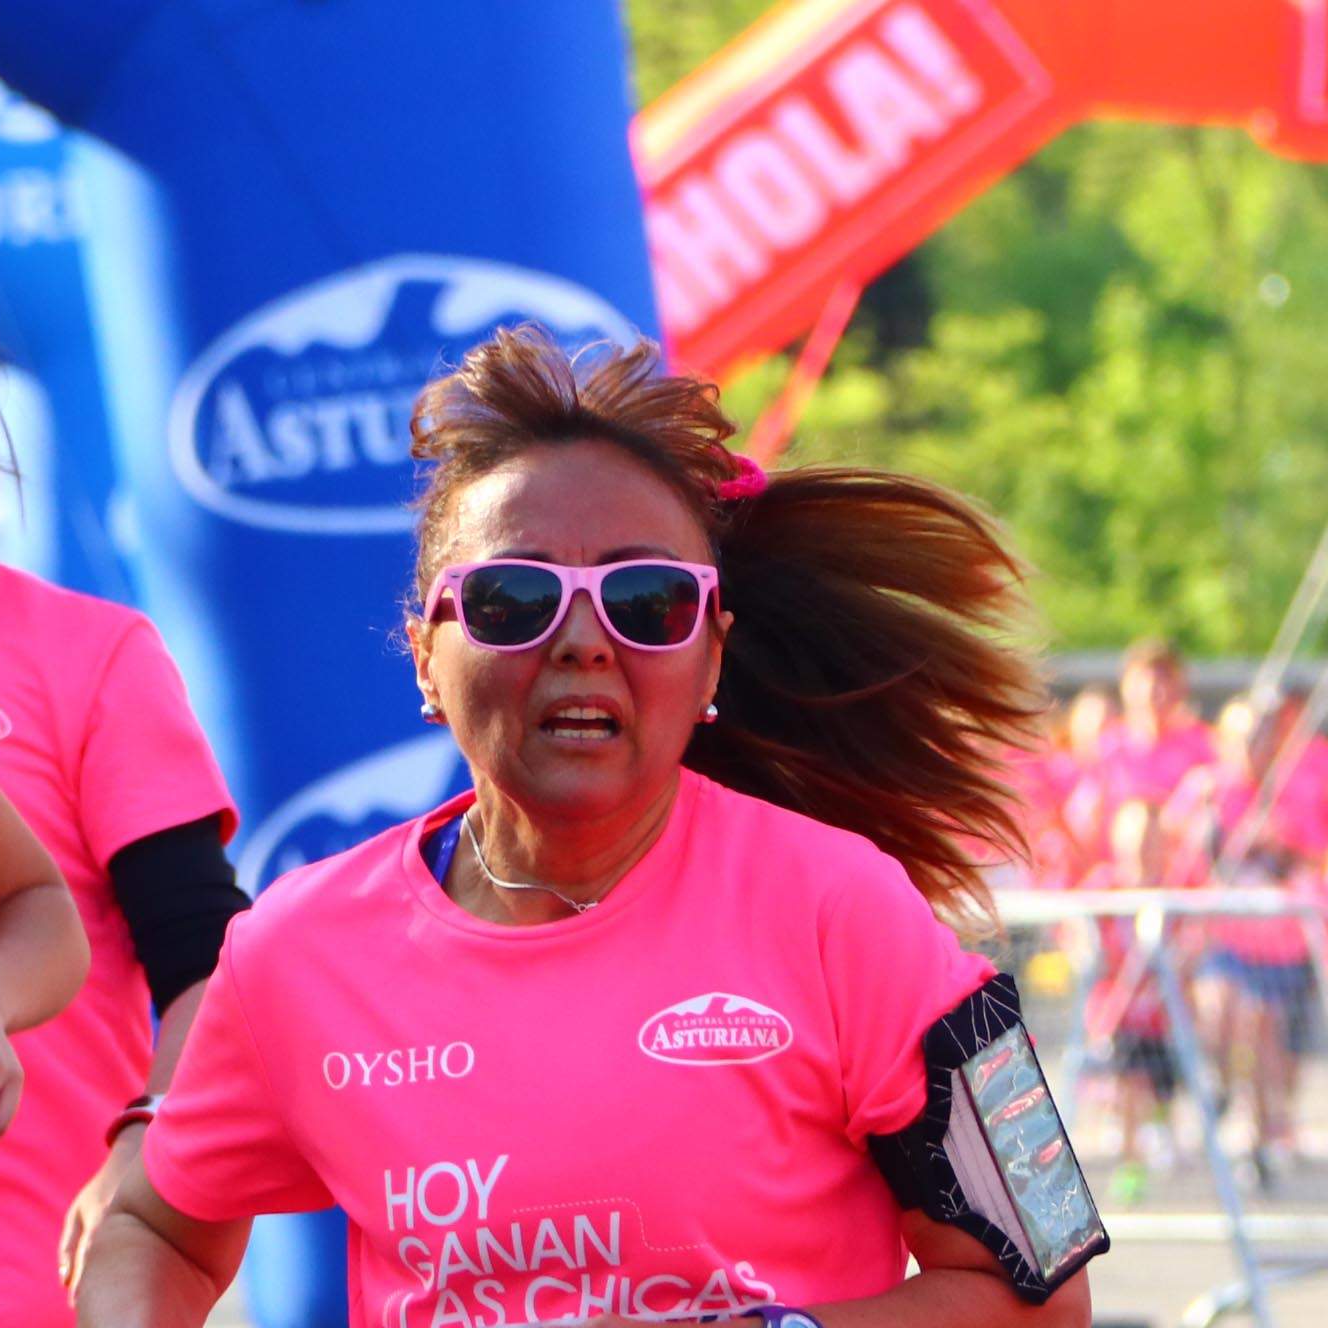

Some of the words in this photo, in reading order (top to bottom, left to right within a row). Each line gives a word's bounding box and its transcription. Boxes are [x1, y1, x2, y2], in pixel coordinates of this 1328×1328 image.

[323, 1041, 474, 1090] OYSHO
[651, 1023, 780, 1050] ASTURIANA
[384, 1154, 509, 1230] HOY
[398, 1211, 621, 1292] GANAN
[525, 1260, 782, 1326] CHICAS
